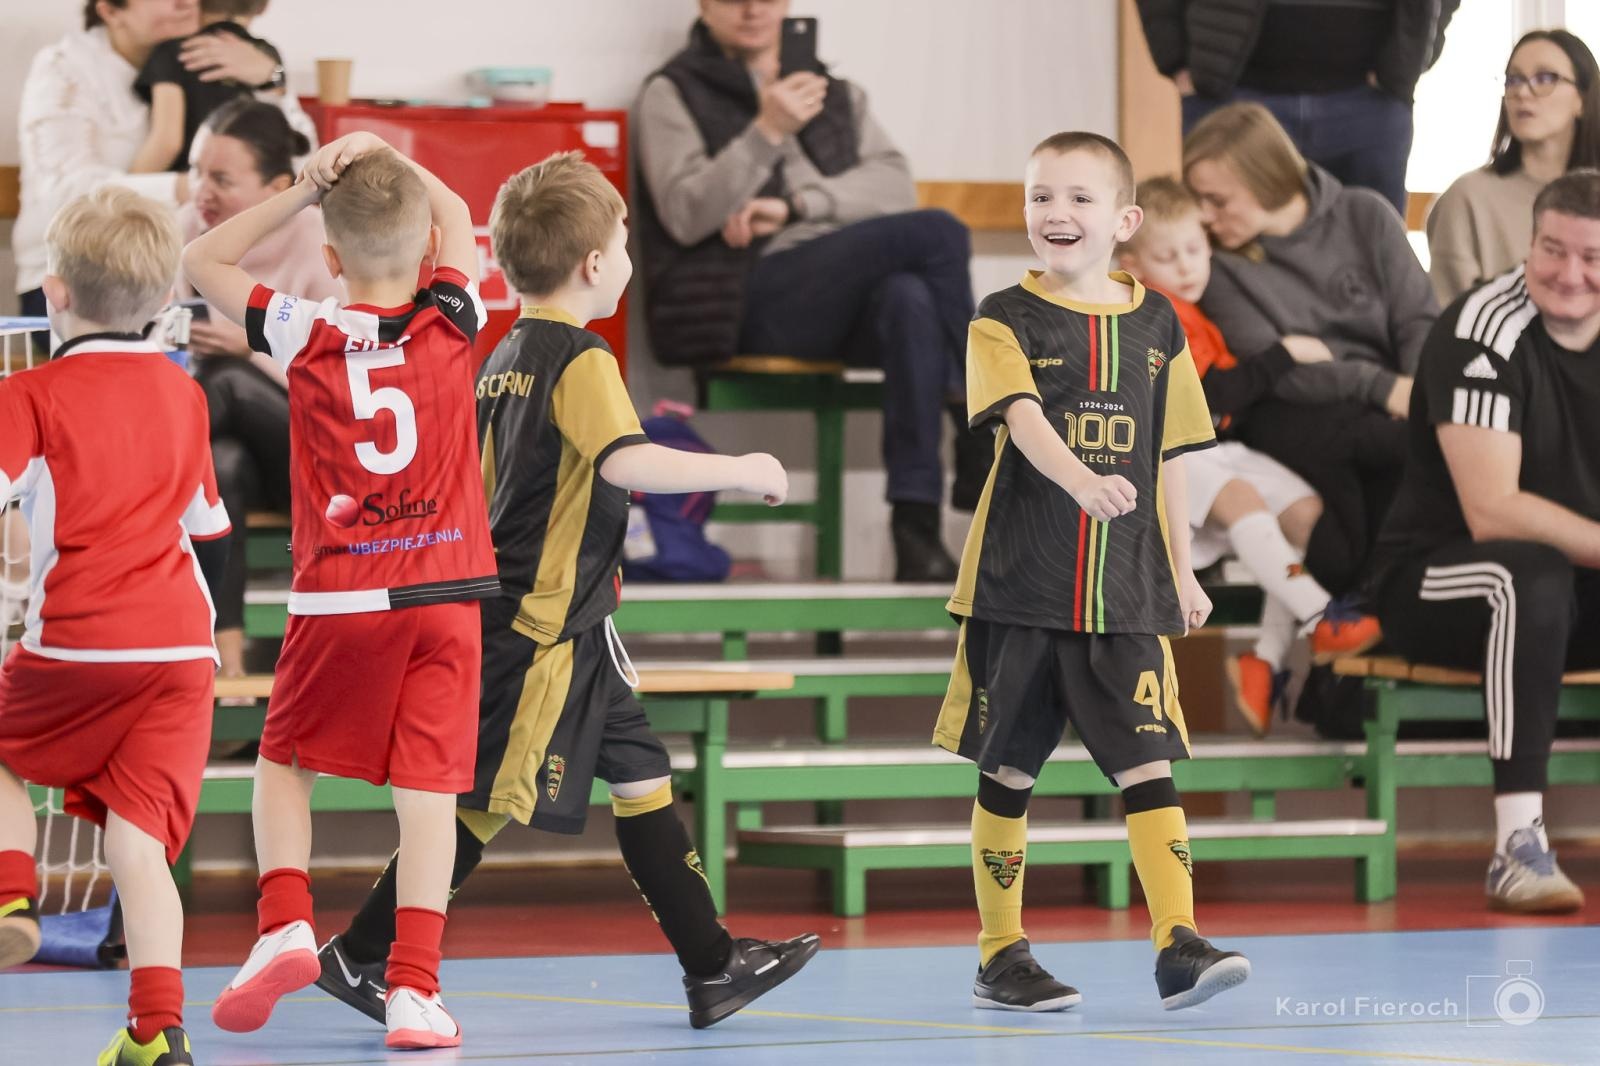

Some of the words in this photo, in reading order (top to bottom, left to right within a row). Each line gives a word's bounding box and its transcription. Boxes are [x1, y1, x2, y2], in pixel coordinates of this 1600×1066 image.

[1029, 358, 1063, 368] egio
[345, 346, 418, 475] 5
[1079, 401, 1124, 411] 1924-2024
[1064, 412, 1136, 453] 100
[1081, 453, 1117, 465] LECIE
[1133, 670, 1162, 721] 4
